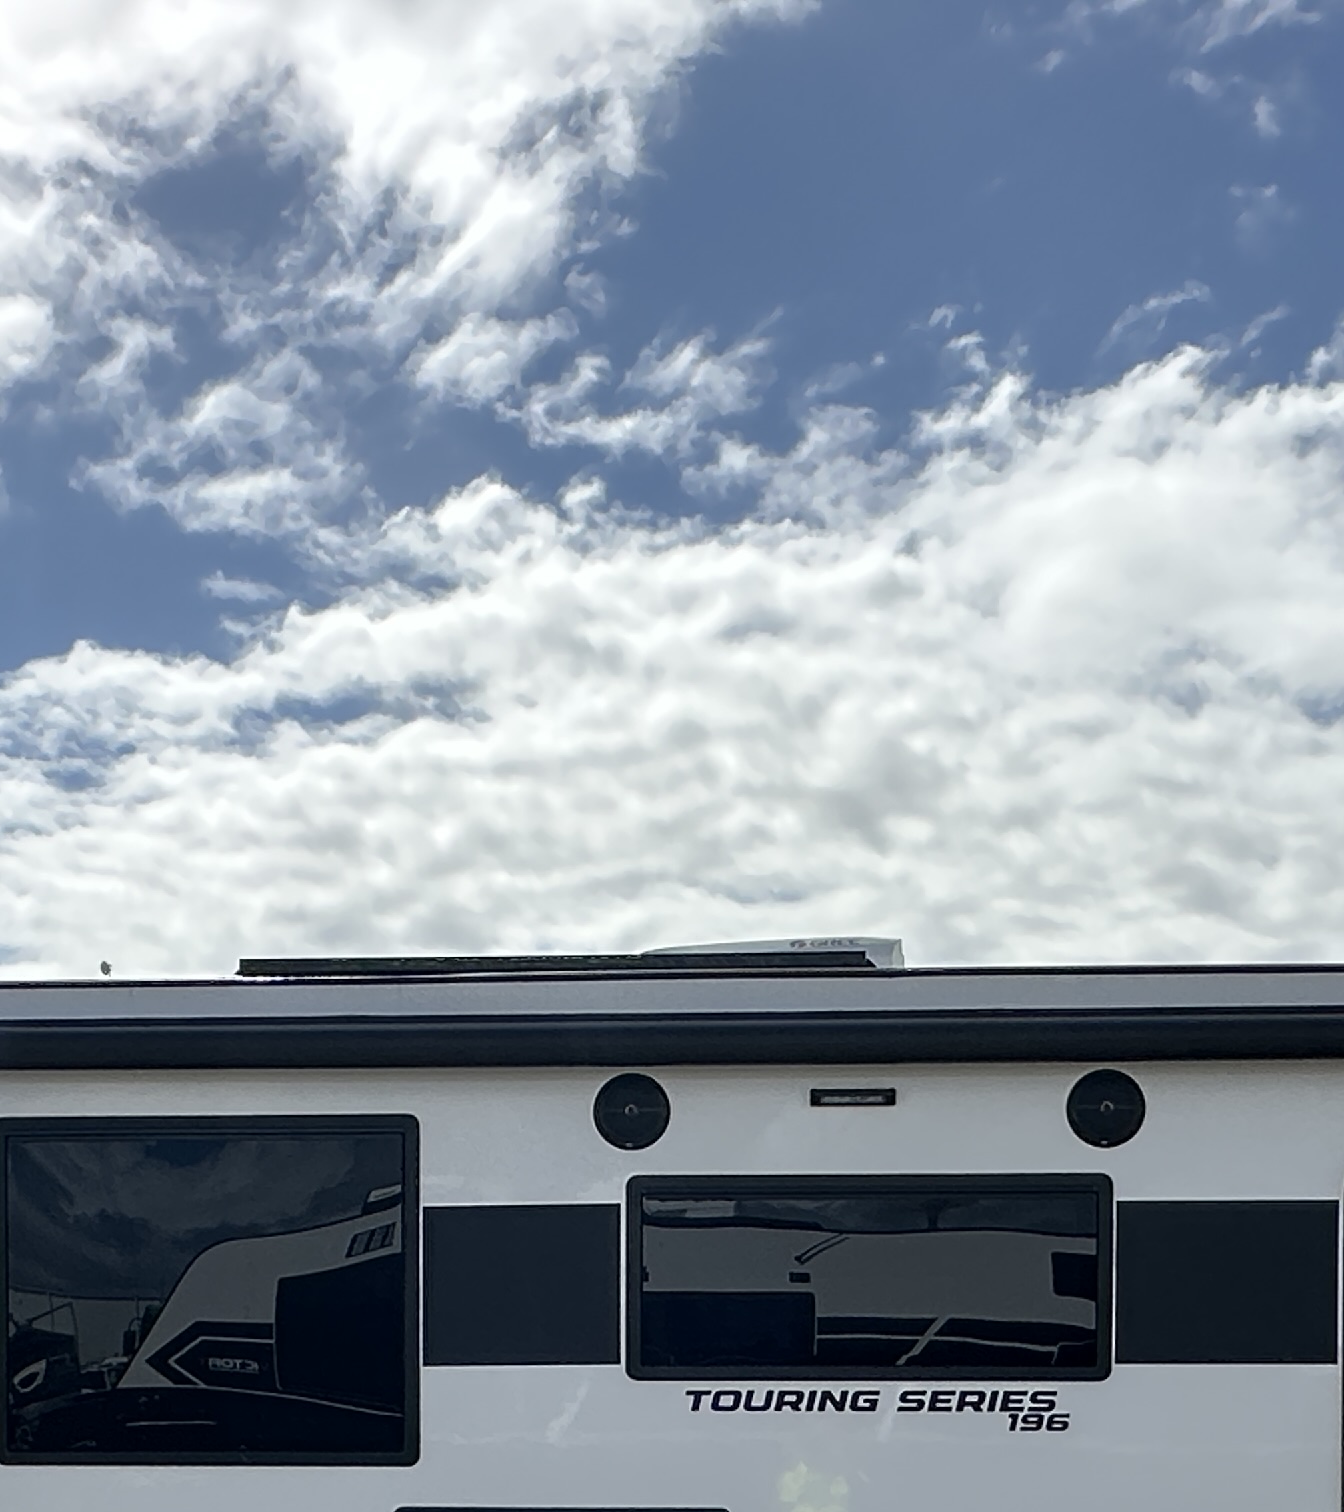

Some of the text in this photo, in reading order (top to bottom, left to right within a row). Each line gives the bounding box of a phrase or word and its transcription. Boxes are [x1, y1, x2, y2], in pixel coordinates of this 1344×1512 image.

[685, 1389, 1058, 1413] TOURING SERIES
[1007, 1412, 1071, 1432] 196
